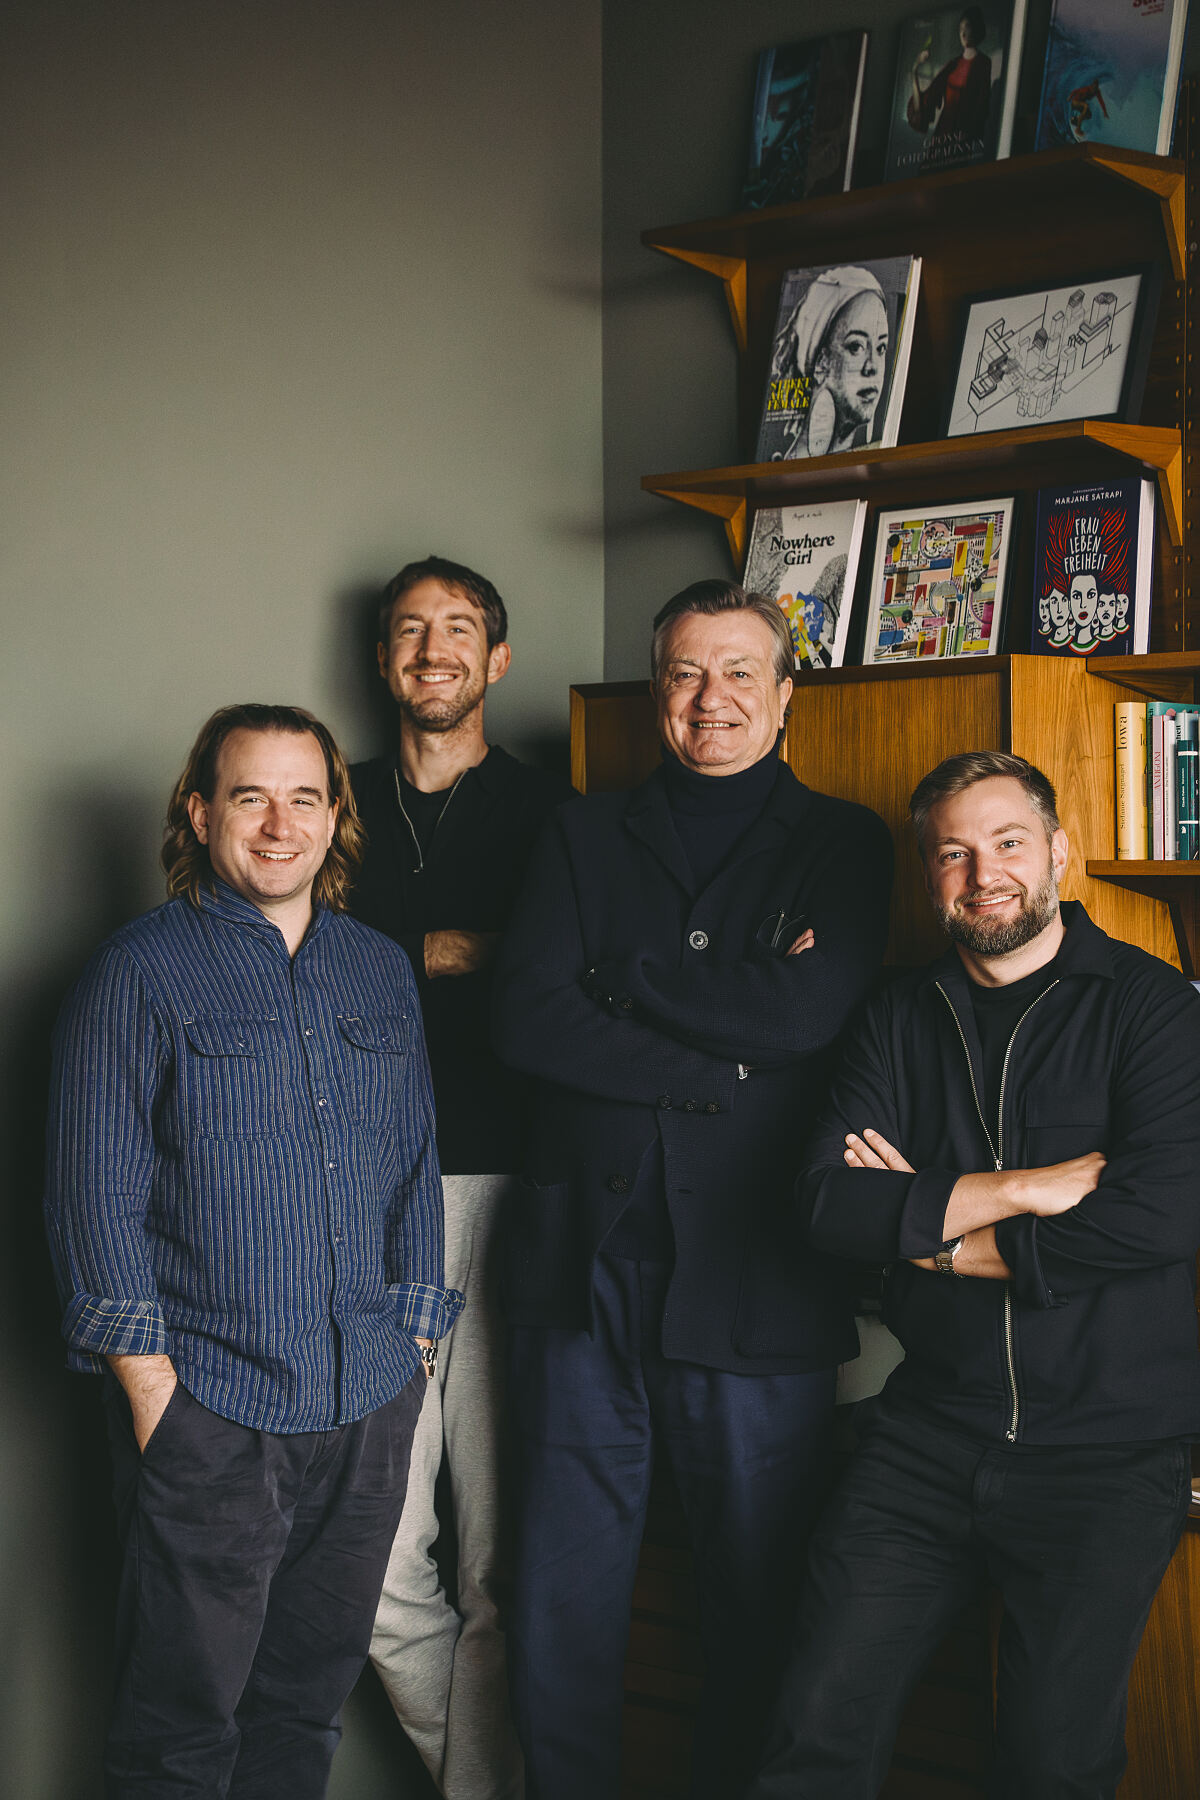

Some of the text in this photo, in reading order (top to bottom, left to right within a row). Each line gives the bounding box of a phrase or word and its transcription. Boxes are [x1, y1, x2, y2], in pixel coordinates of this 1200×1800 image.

[767, 396, 811, 411] FEMALE
[1054, 494, 1089, 505] MARJANE
[1091, 490, 1123, 501] SATRAPI
[1075, 516, 1100, 536] FRAU
[769, 533, 835, 552] Nowhere
[1069, 534, 1102, 555] LEBEN
[783, 549, 813, 566] Girl
[1064, 552, 1108, 575] FREIHEIT
[1116, 715, 1128, 750] Iowa
